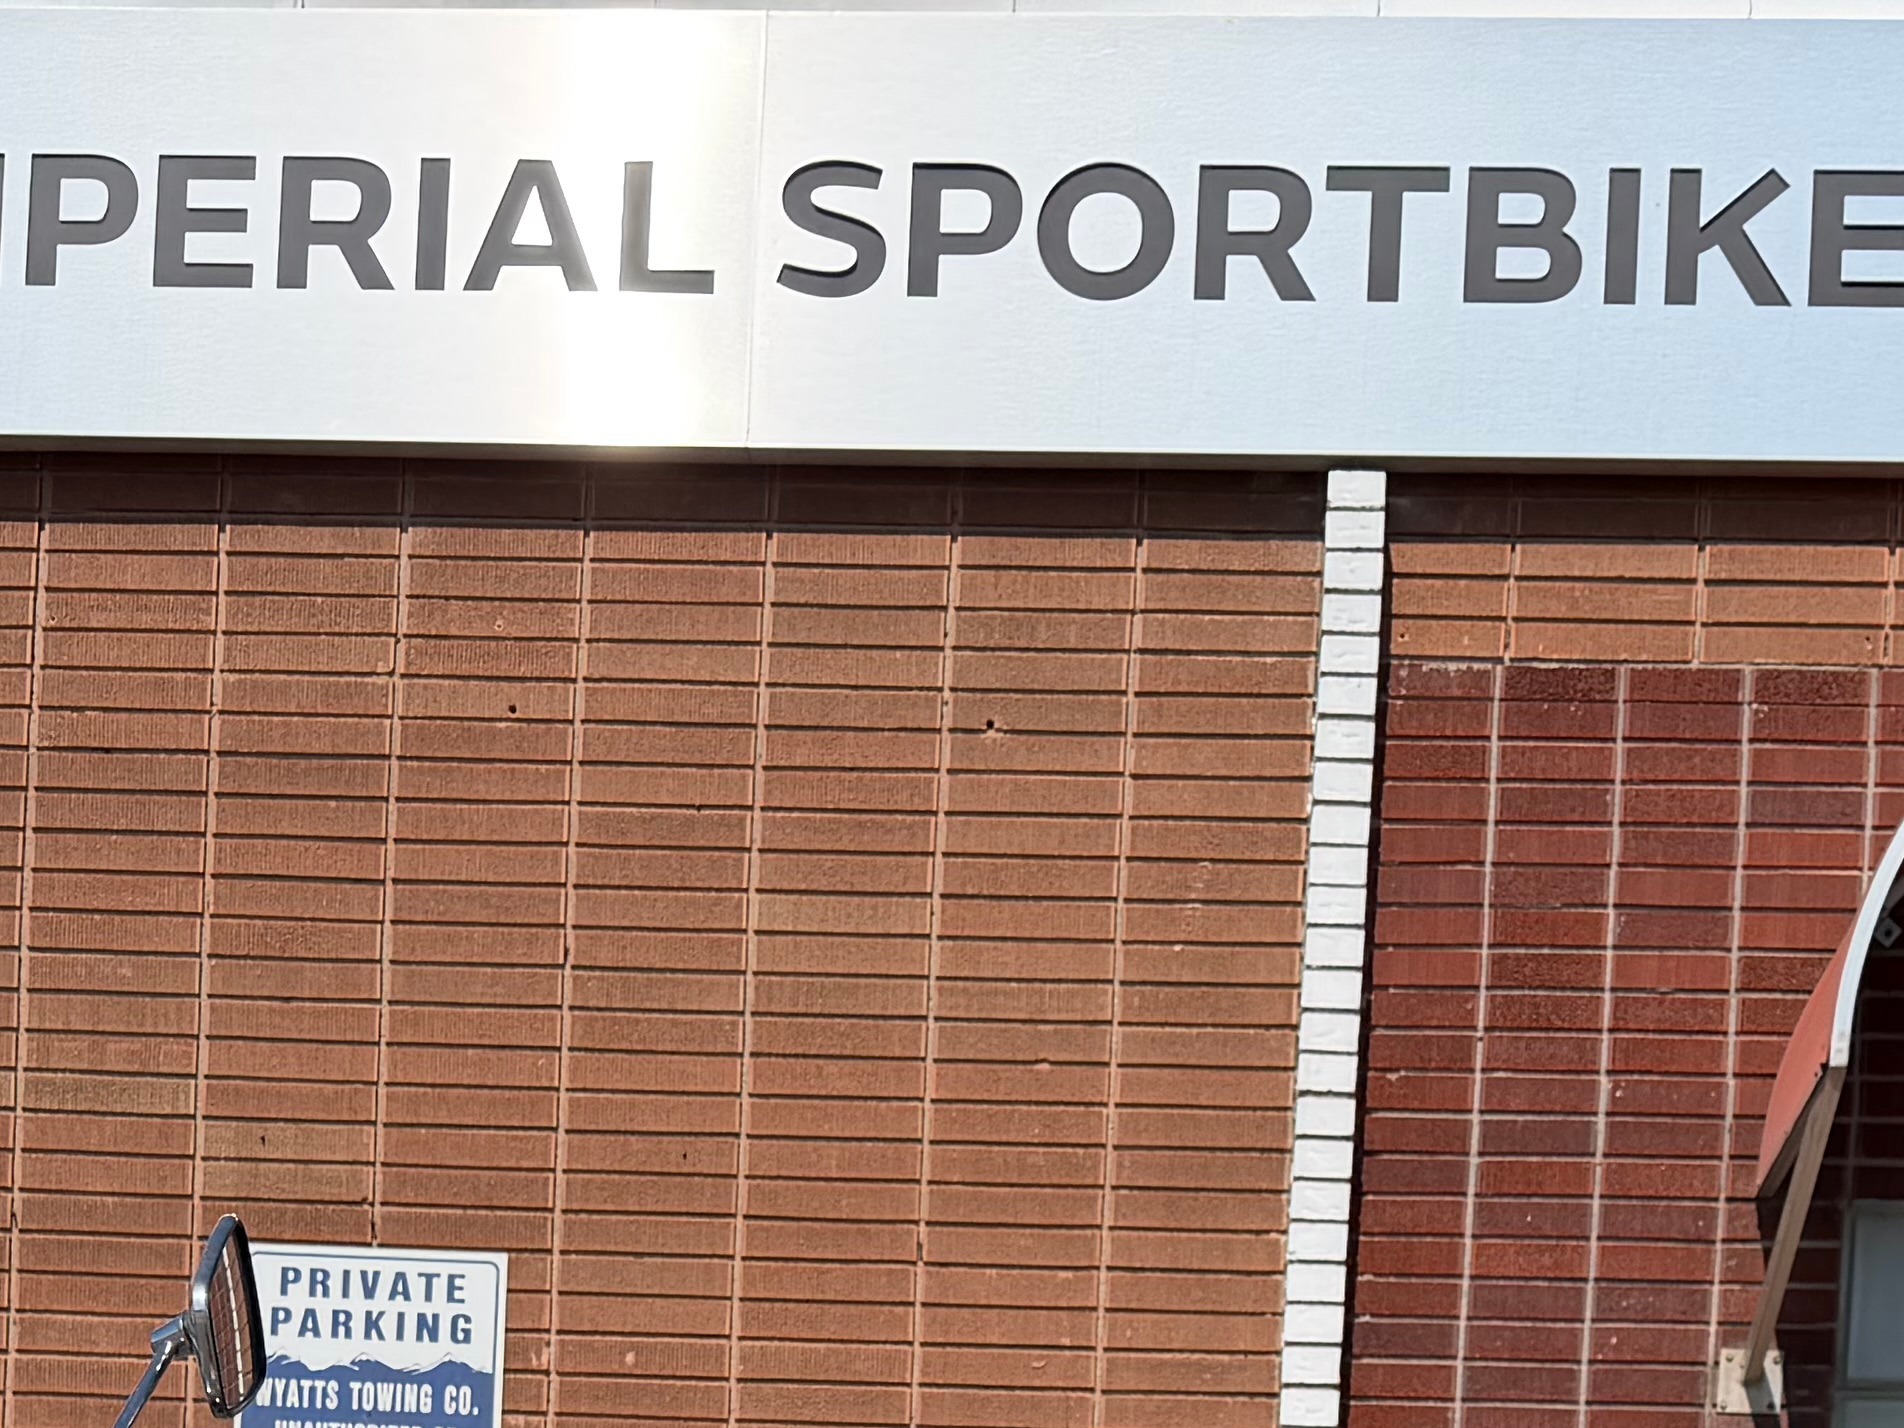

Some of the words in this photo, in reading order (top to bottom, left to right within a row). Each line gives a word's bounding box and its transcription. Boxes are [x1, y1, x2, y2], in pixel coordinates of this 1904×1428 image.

[280, 1266, 467, 1304] PRIVATE
[270, 1306, 473, 1345] PARKING
[256, 1377, 339, 1410] WYATTS
[349, 1381, 433, 1414] TOWING
[443, 1384, 479, 1416] CO.
